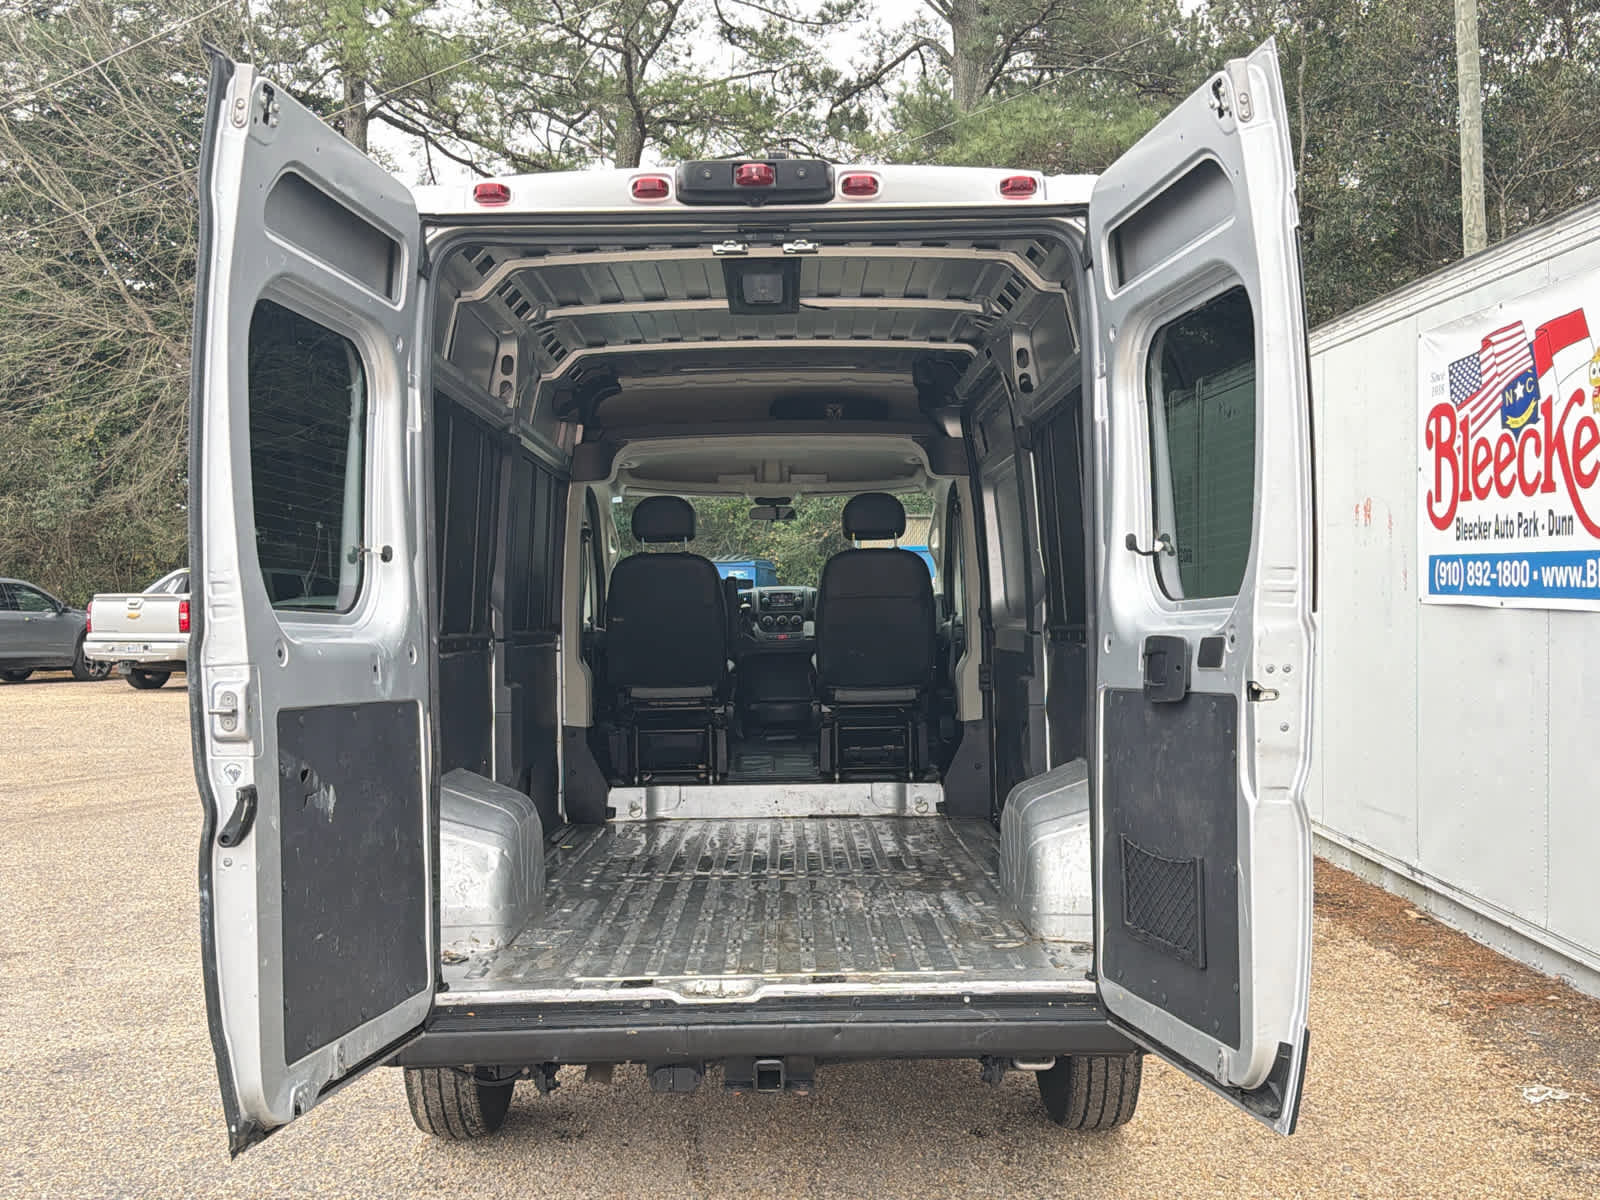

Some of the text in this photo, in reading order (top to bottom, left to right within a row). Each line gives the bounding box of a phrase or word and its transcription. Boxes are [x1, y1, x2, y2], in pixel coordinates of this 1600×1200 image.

[1505, 377, 1535, 407] N C
[1456, 509, 1574, 541] Bleecker Auto Park Dunn
[1435, 558, 1464, 592] (910)
[1466, 560, 1529, 587] 892-1800
